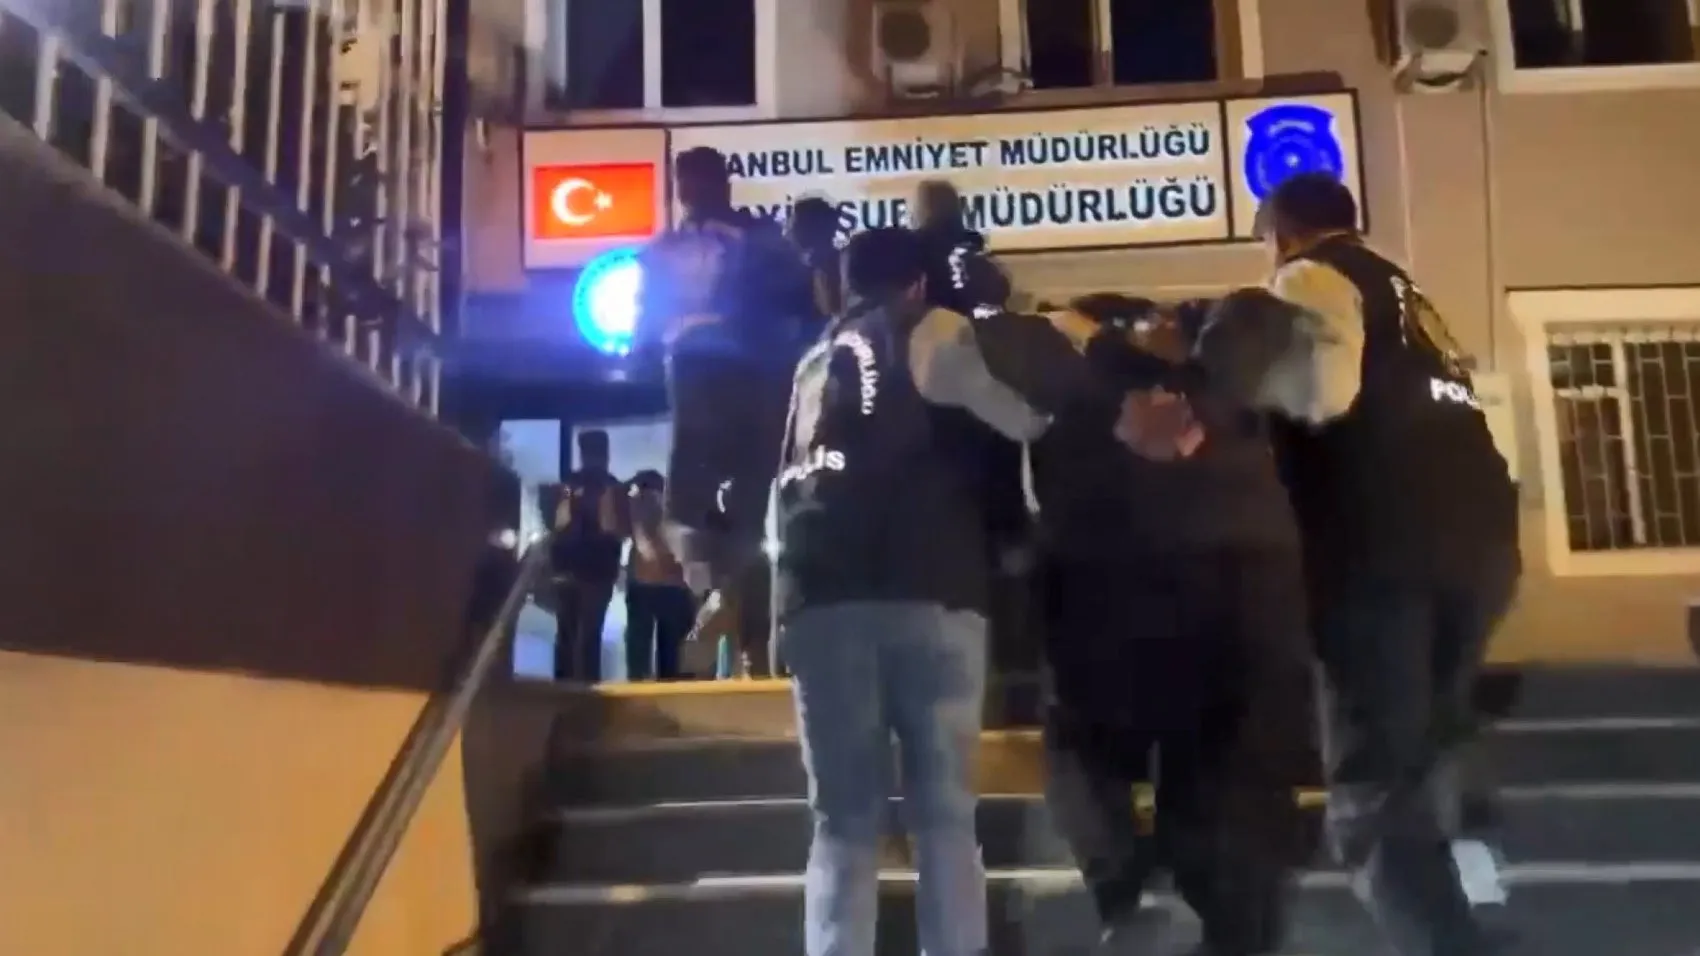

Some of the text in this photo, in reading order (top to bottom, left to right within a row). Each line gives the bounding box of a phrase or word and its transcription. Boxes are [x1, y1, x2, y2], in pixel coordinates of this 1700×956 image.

[726, 122, 1211, 178] ANBUL EMNİYET MÜDÜRLÜĞÜ
[959, 175, 1217, 231] MÜDÜRLÜĞÜ
